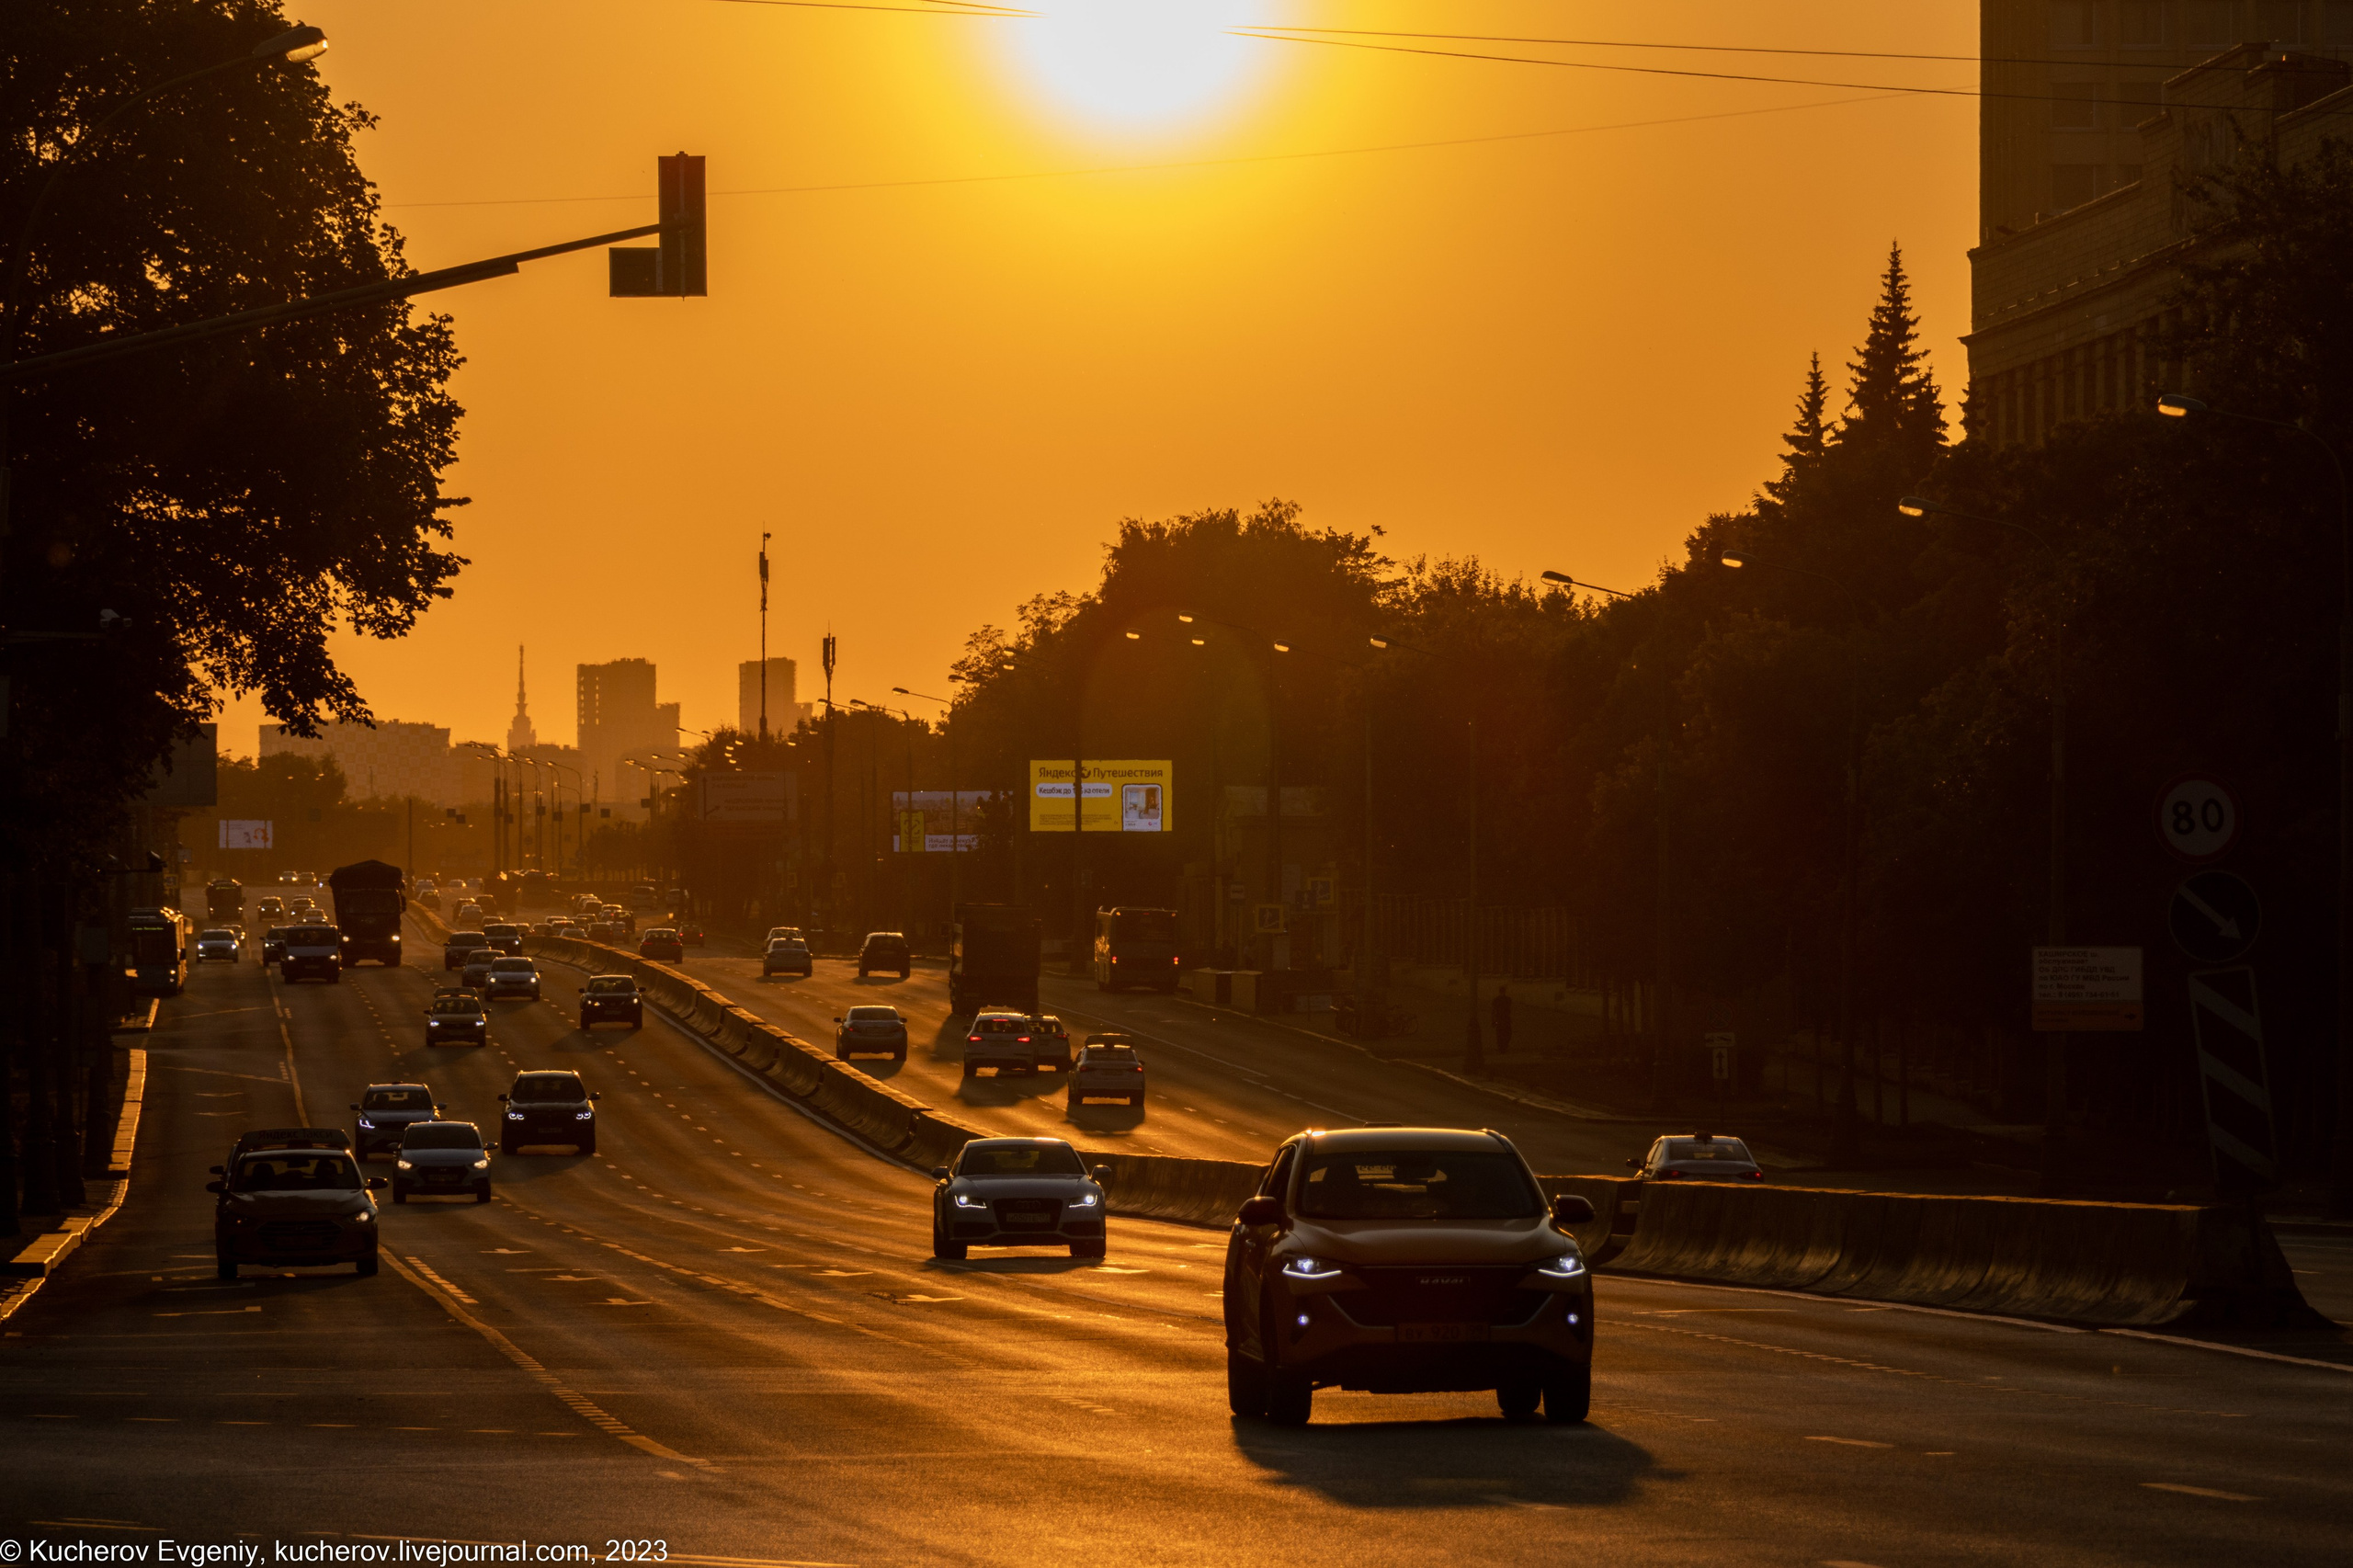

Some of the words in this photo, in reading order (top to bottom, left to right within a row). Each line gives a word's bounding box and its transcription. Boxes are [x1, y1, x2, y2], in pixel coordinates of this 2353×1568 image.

[1039, 767, 1076, 779] Яндекс
[1093, 767, 1164, 779] Путешествия
[1039, 787, 1063, 795] Кешбэк
[2172, 798, 2224, 835] 80
